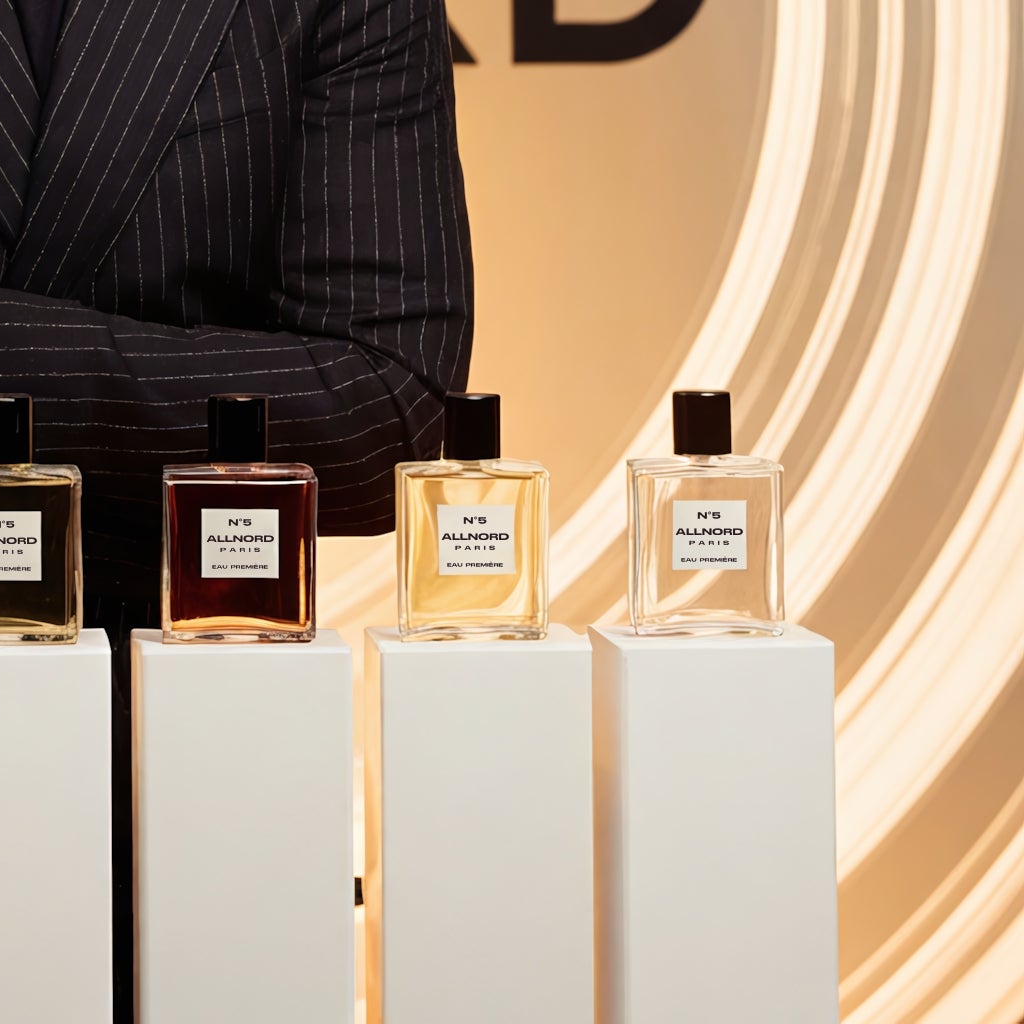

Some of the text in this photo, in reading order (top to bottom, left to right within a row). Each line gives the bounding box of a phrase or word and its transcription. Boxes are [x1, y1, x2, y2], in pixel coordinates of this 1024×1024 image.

[441, 532, 510, 540] ALLNORD
[675, 528, 744, 536] ALLNORD
[206, 534, 275, 542] ALLNORD
